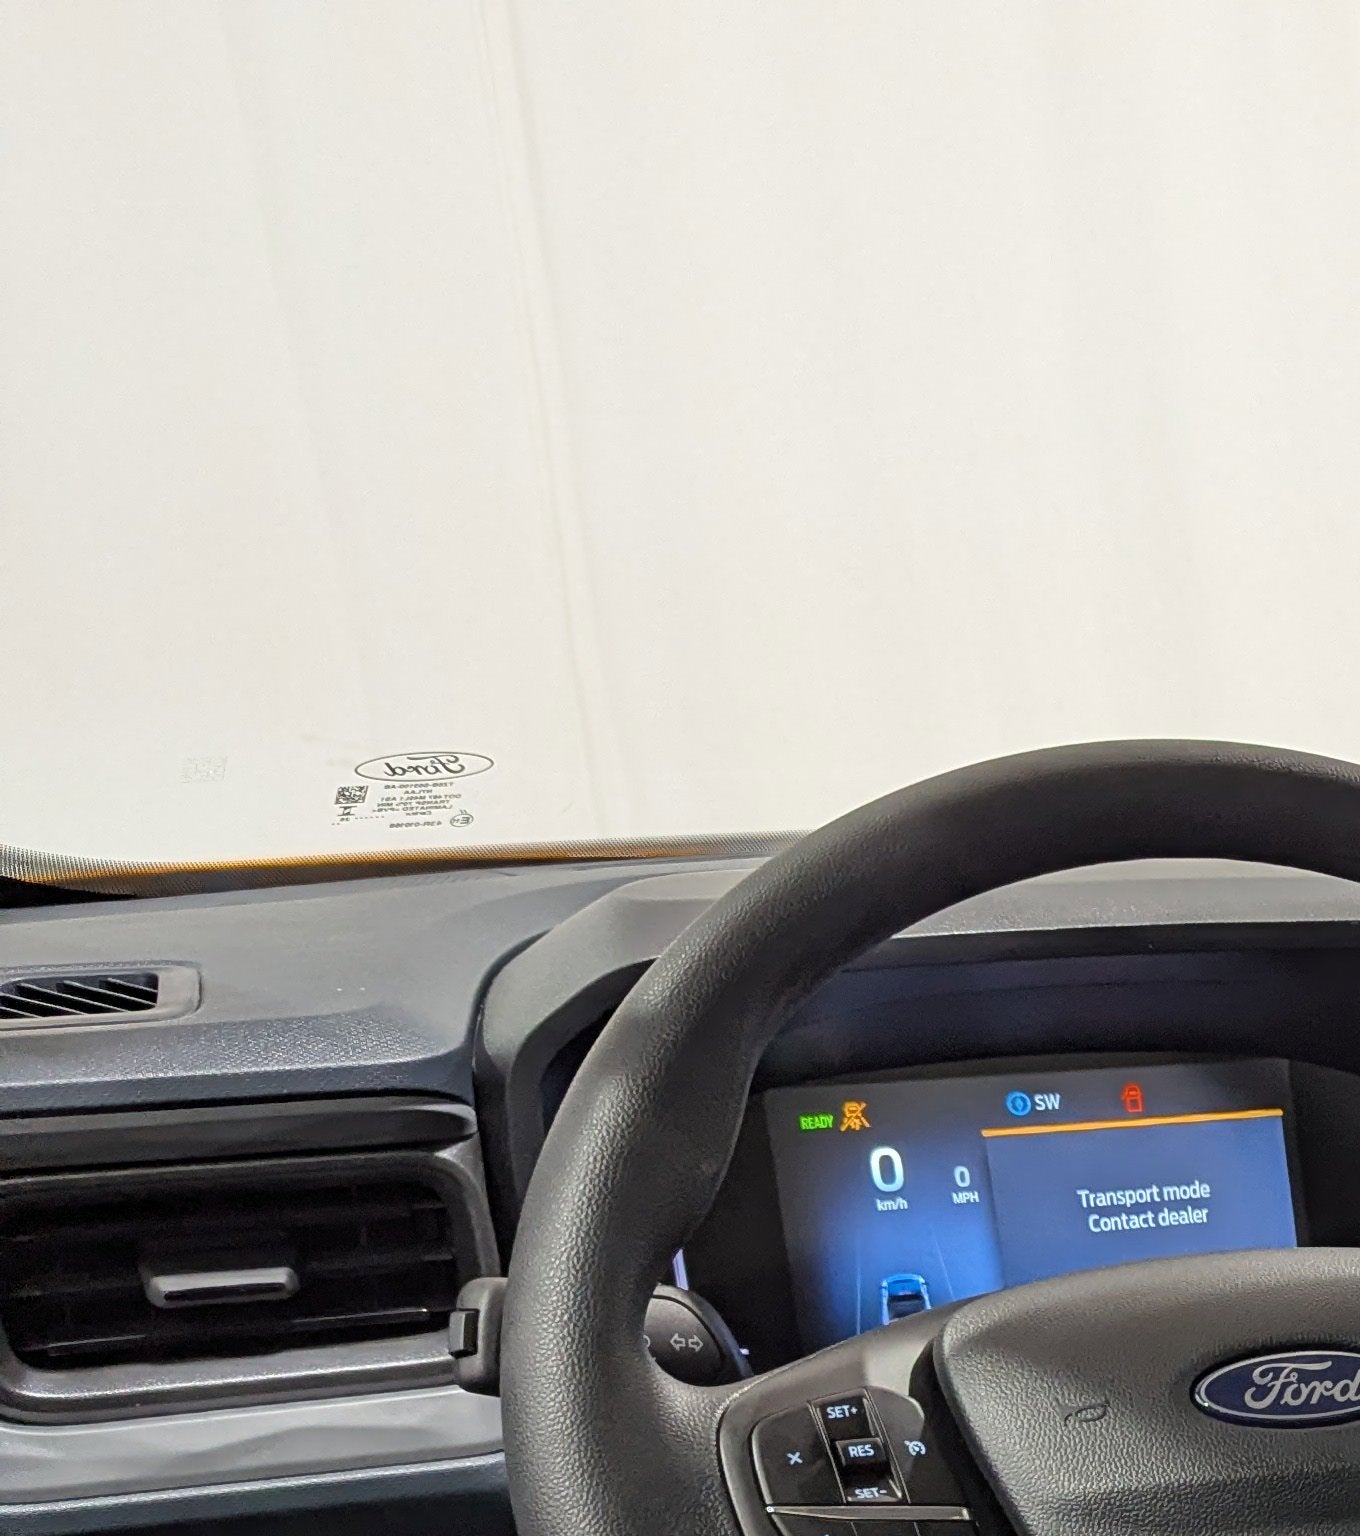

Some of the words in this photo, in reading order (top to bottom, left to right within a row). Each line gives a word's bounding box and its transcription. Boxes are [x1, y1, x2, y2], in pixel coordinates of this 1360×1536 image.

[1034, 1092, 1061, 1112] SW
[800, 1114, 834, 1130] READY
[870, 1146, 904, 1193] 0
[953, 1165, 971, 1188] 0
[952, 1190, 980, 1204] MPH
[1076, 1184, 1160, 1208] Transport
[1162, 1179, 1211, 1201] mode
[876, 1197, 908, 1211] km/h
[1088, 1210, 1156, 1232] Contact
[1158, 1205, 1208, 1227] dealer
[848, 1443, 875, 1458] RES
